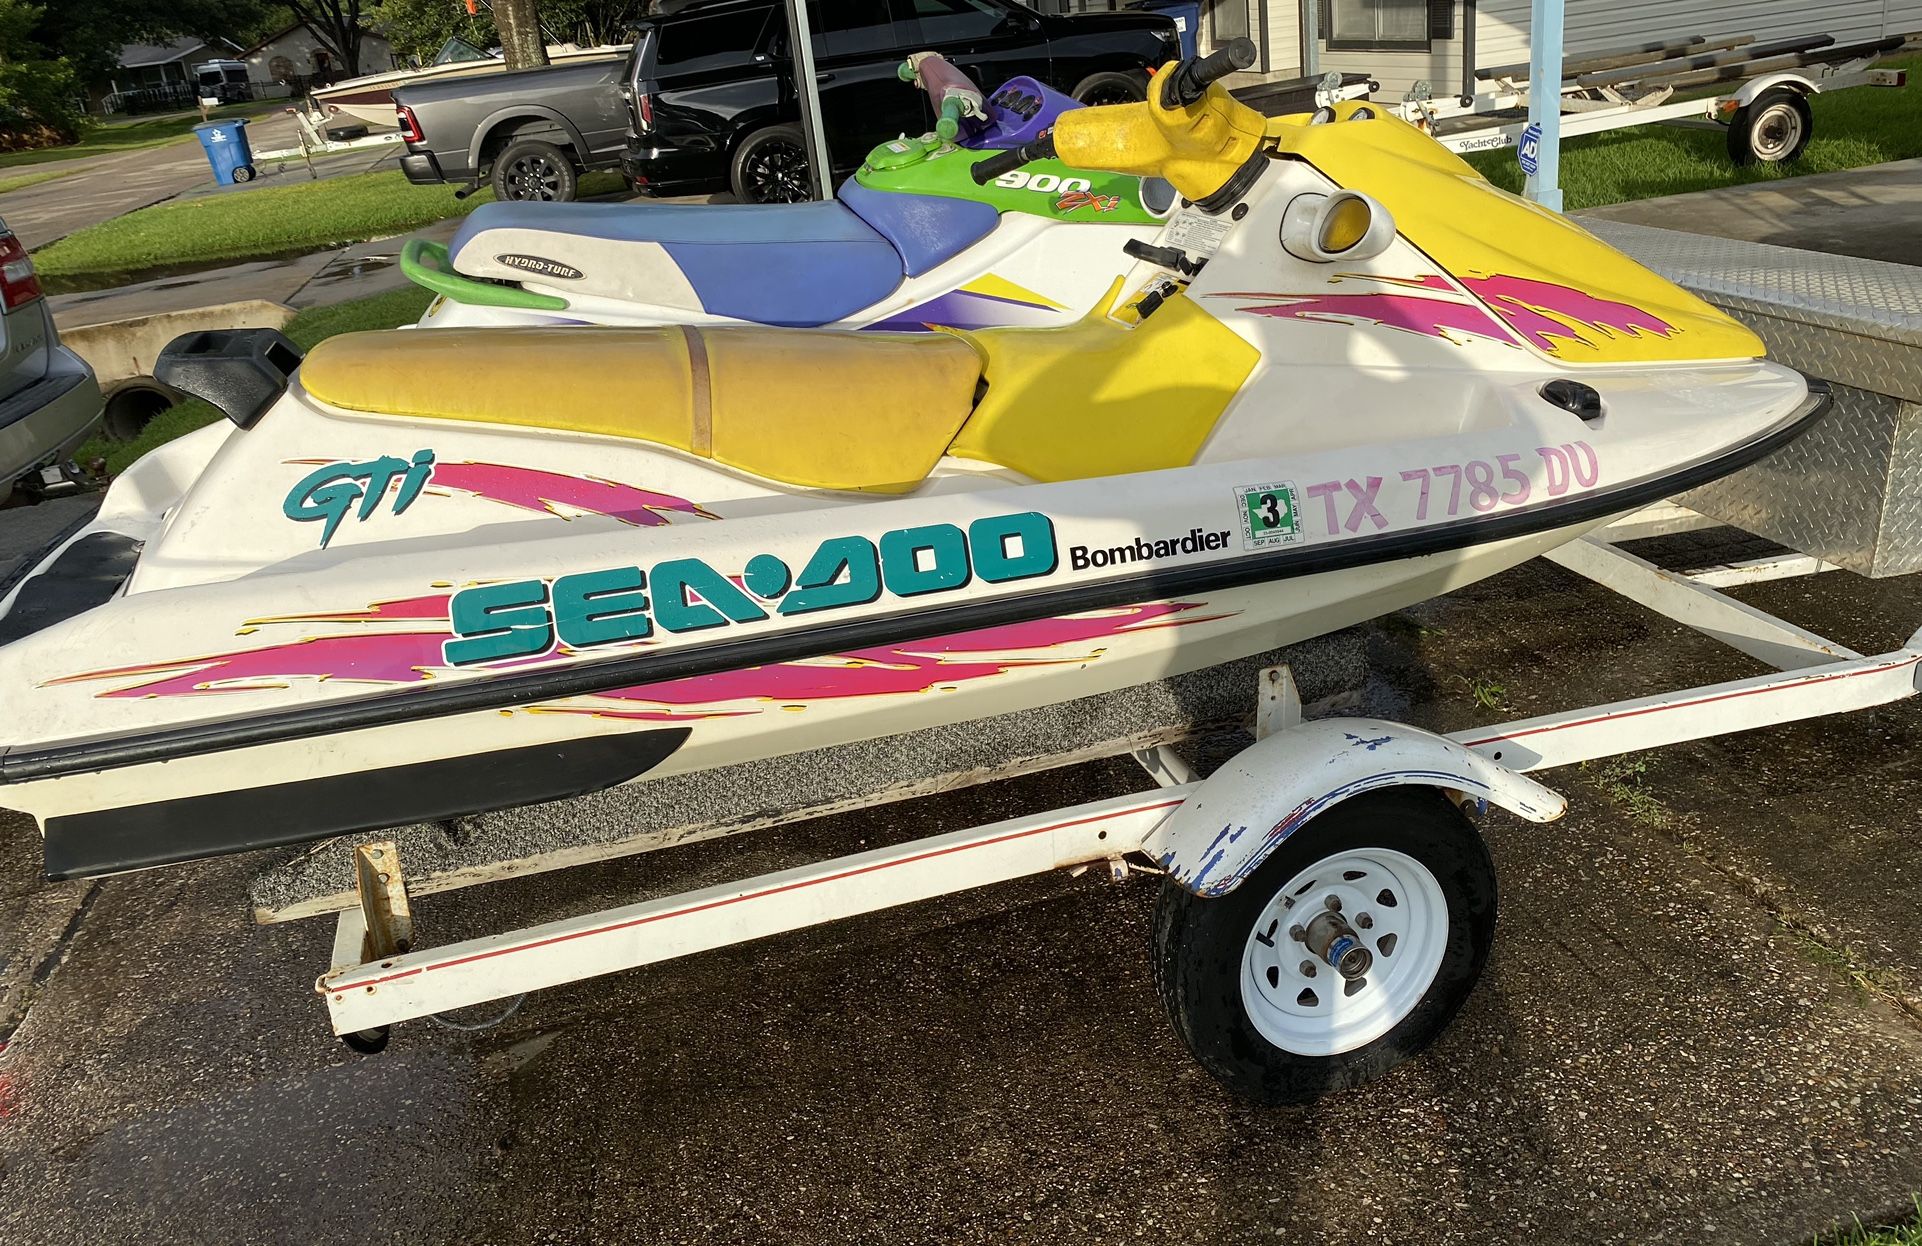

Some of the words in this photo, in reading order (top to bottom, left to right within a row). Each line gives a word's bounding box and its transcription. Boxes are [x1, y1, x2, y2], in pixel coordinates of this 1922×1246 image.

[995, 170, 1091, 194] 900
[505, 256, 576, 277] HYDRO-TURF
[1306, 475, 1389, 535] TX
[1399, 453, 1531, 521] 7785
[1535, 440, 1600, 497] DU
[1261, 493, 1280, 528] 3
[1070, 528, 1231, 571] Bombardier
